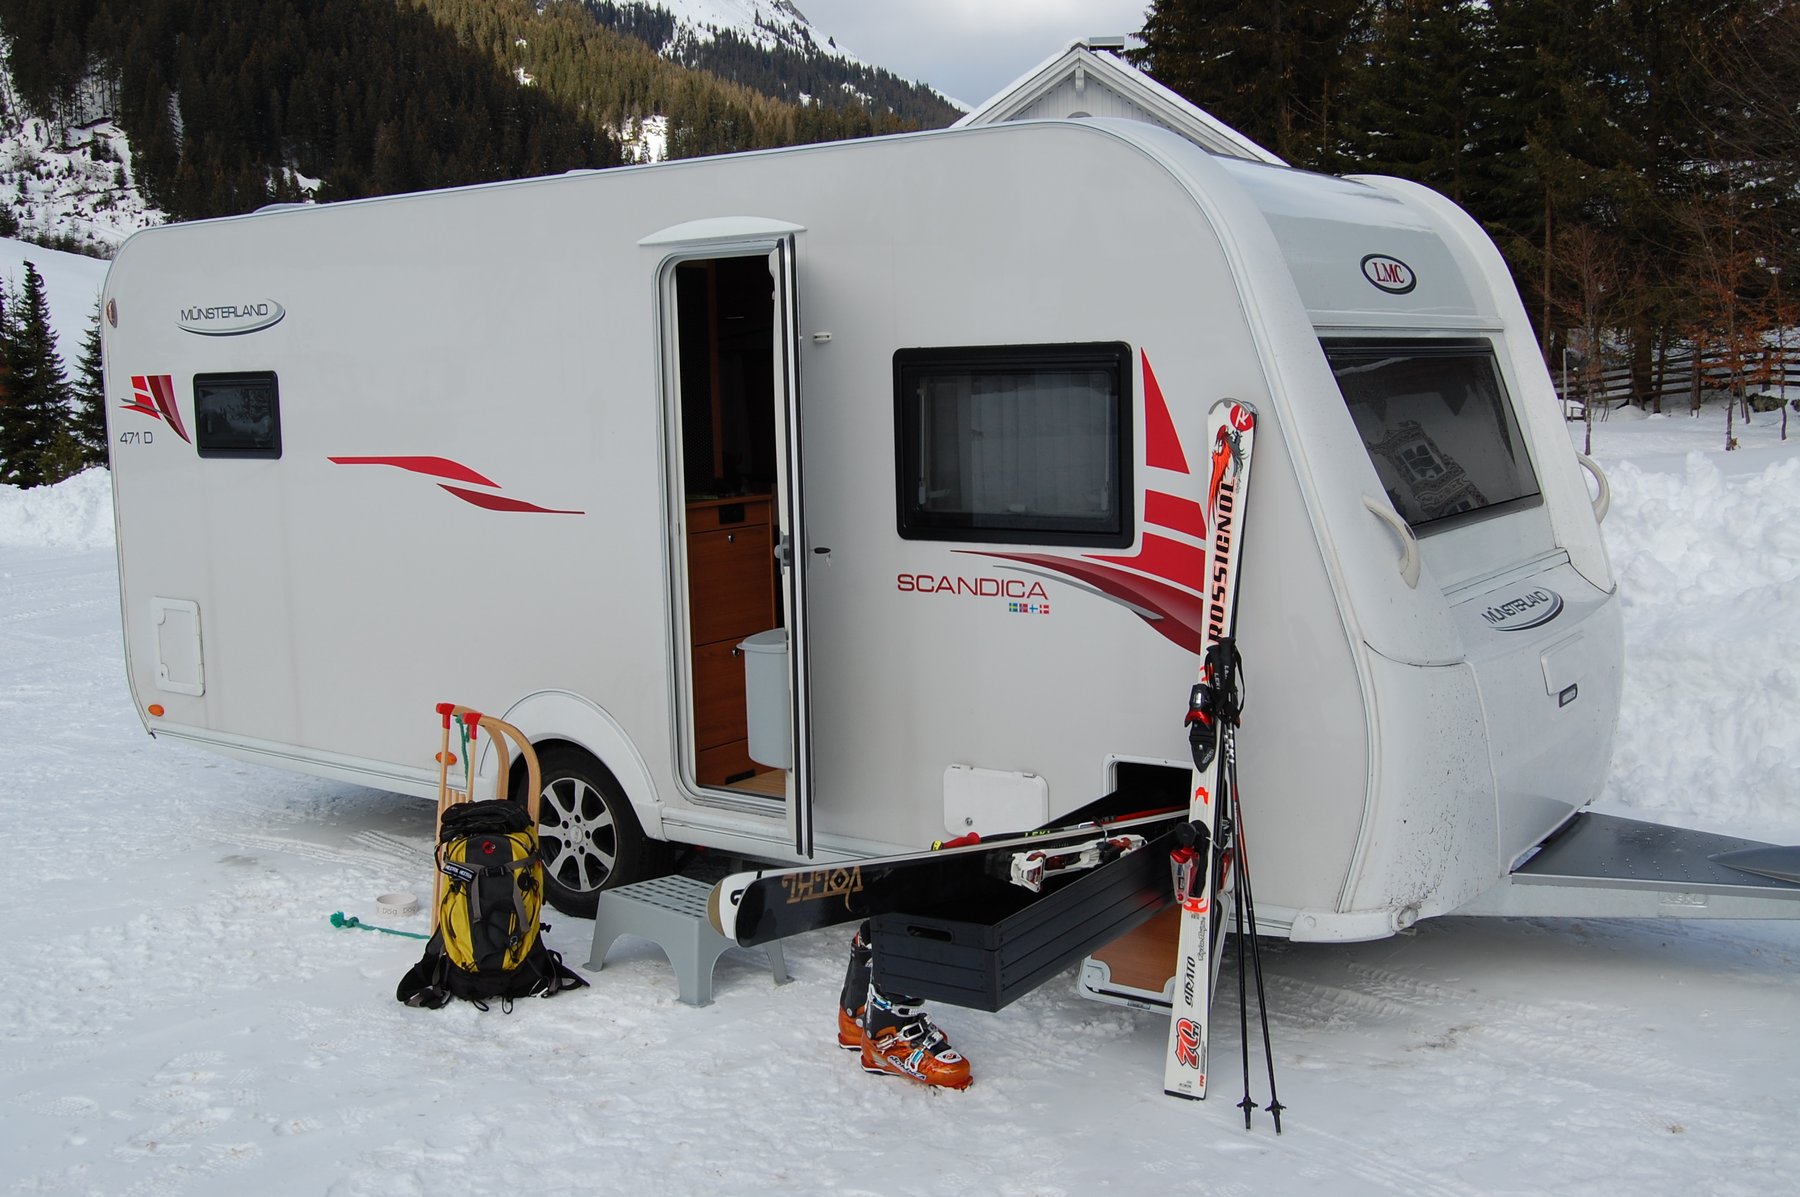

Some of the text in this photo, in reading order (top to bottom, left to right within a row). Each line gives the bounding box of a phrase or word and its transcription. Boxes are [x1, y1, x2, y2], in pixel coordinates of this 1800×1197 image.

[1372, 261, 1405, 284] LMC
[181, 303, 269, 321] MÜNSTERLAND
[119, 431, 154, 445] 471 D
[1207, 478, 1235, 643] ROSSIGNOL
[897, 573, 1049, 600] SCANDICA
[1481, 590, 1549, 624] MÜNSTERLAND
[1184, 956, 1196, 1007] STRATO
